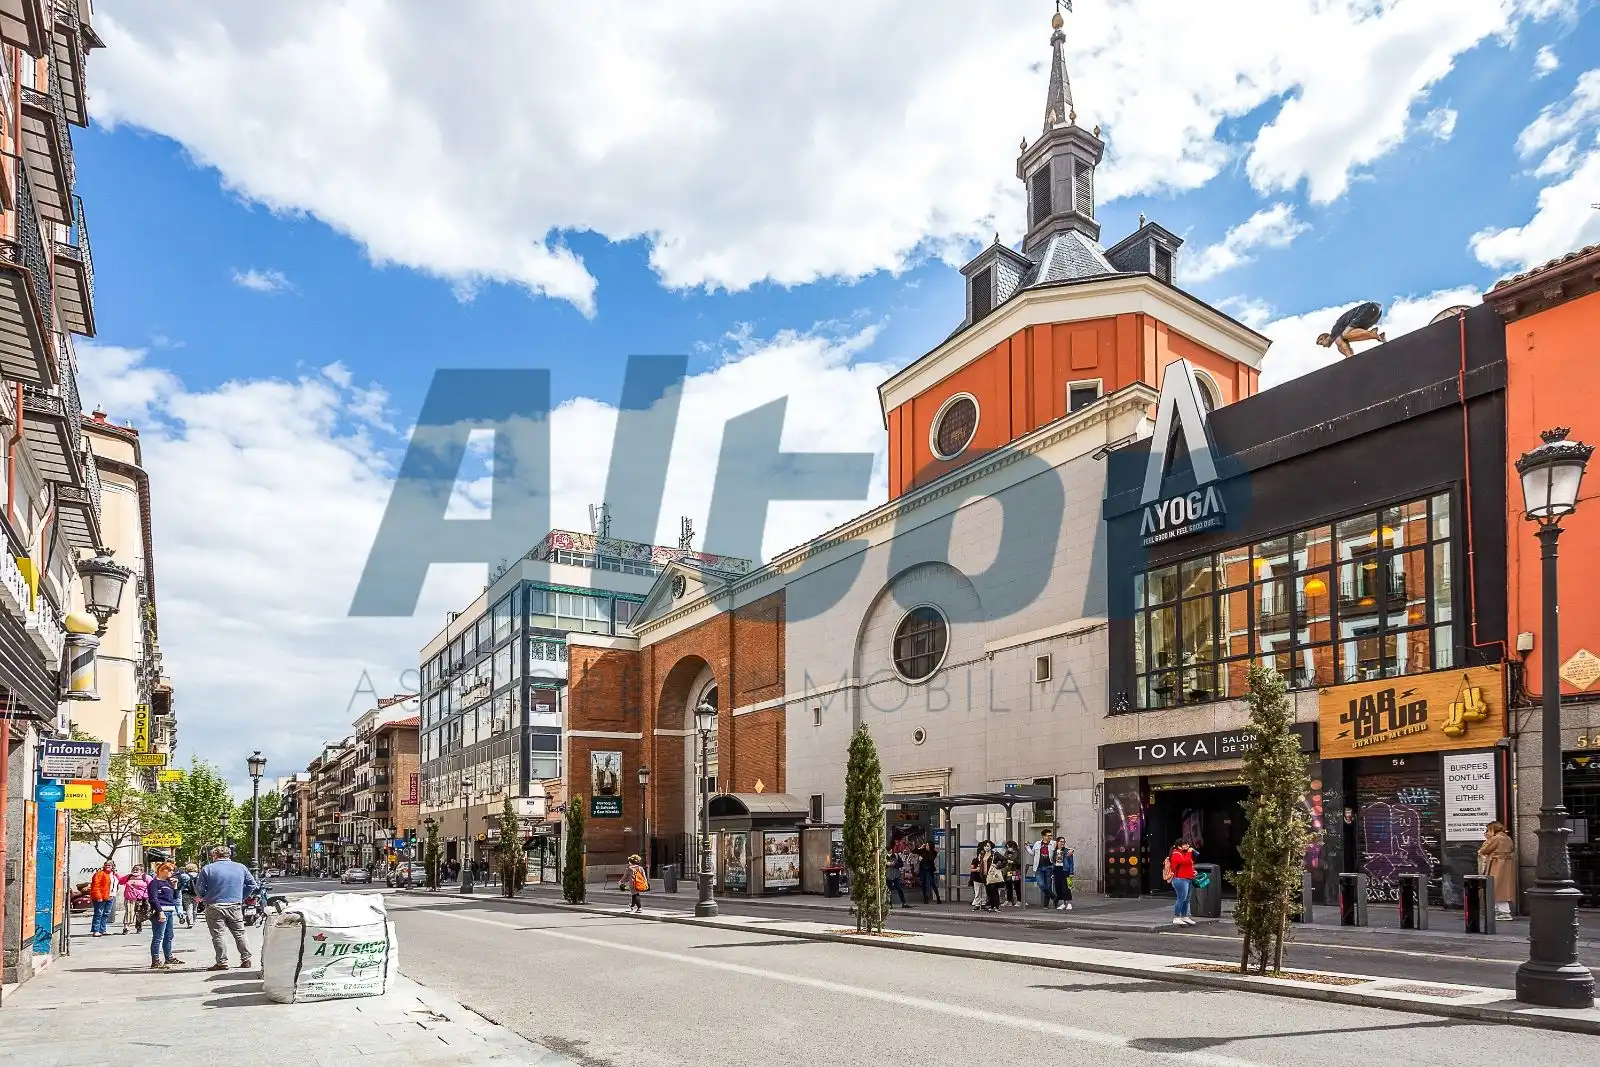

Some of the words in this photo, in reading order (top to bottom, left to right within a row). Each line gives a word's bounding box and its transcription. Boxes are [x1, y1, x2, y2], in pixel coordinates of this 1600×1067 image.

[1155, 532, 1169, 542] GOOD
[1176, 527, 1189, 536] FEEL
[1189, 522, 1202, 531] GOOD
[137, 706, 146, 748] HOSTAL
[1353, 700, 1428, 740] CLUB
[1388, 723, 1428, 739] METHOD
[47, 743, 100, 755] infomax
[1134, 739, 1209, 761] TOKA
[1222, 745, 1237, 753] DE
[1450, 763, 1488, 772] BURPEES
[314, 943, 327, 956] A
[331, 943, 350, 956] TU
